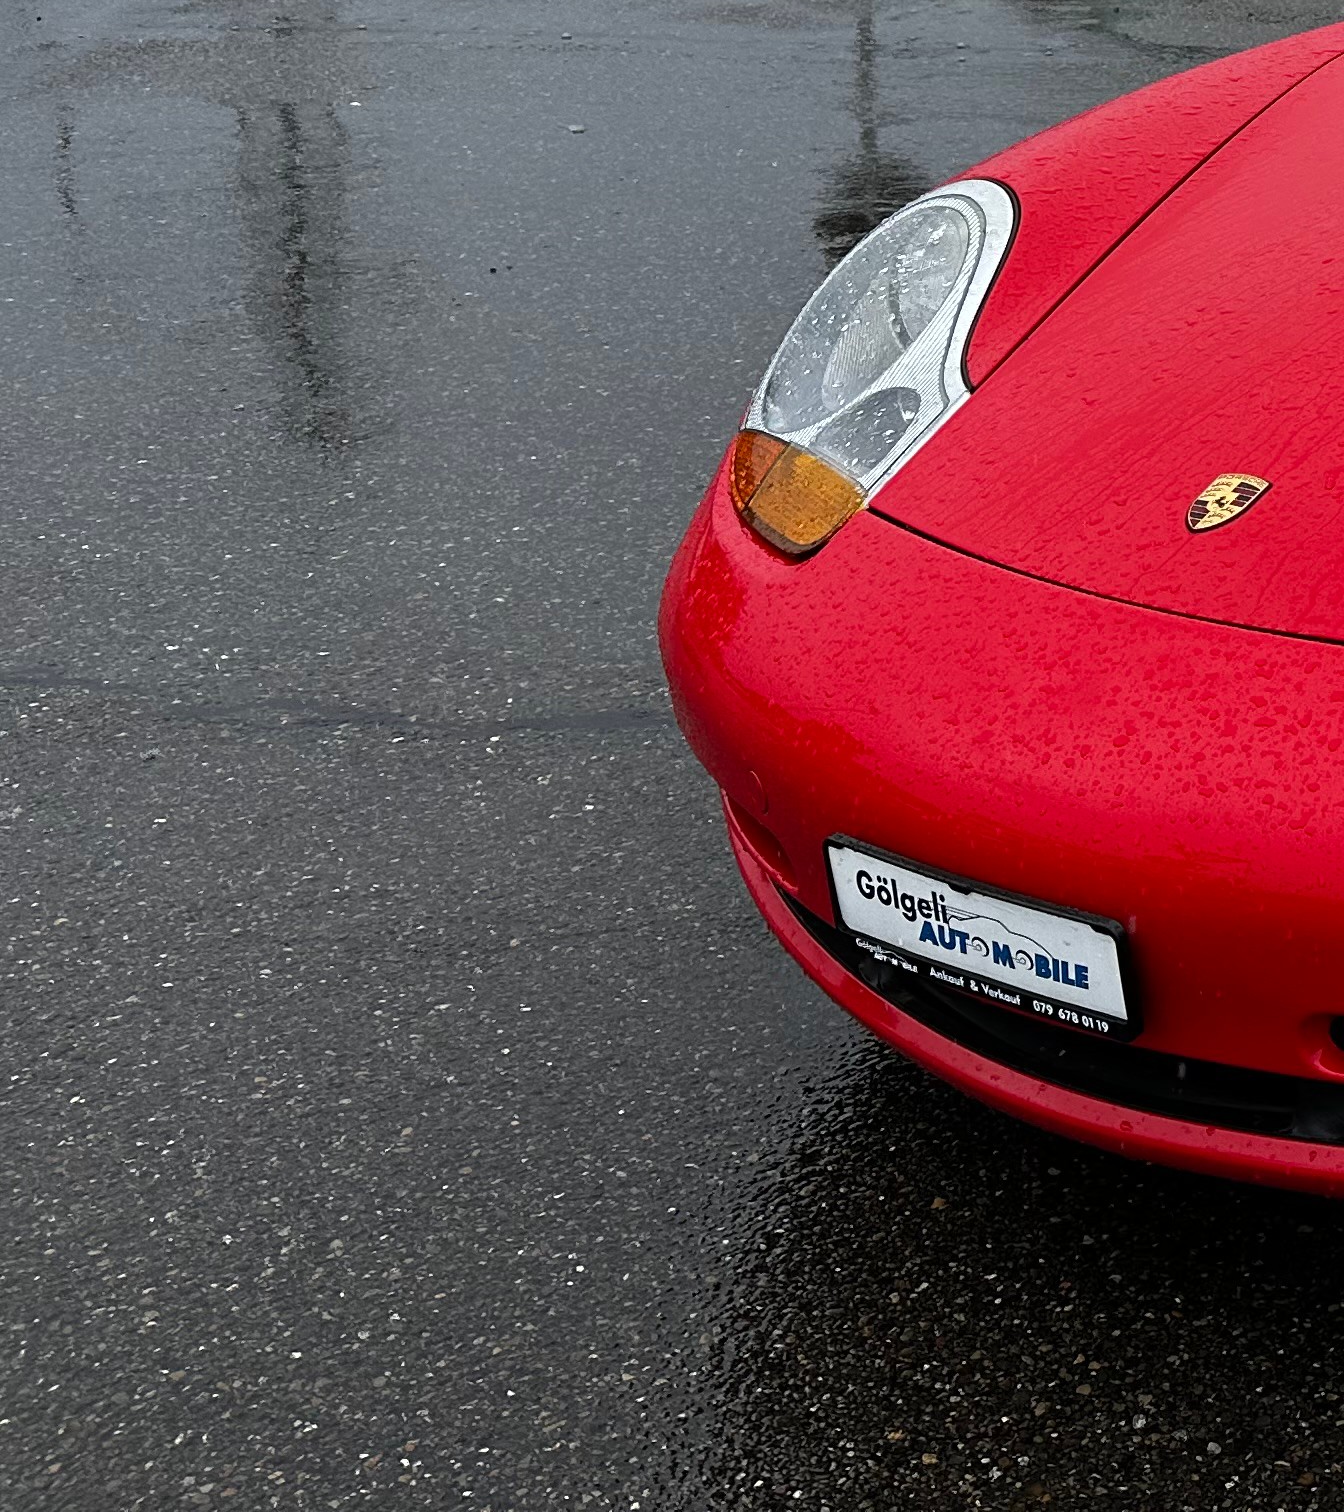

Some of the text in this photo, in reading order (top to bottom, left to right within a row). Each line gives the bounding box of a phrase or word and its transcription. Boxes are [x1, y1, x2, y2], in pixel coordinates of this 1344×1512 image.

[856, 869, 948, 925] Gölgeli
[919, 920, 1090, 990] AUTOMOBILE
[929, 966, 965, 988] Ankauf
[969, 979, 980, 993] &
[981, 982, 1021, 1006] Verkauf
[1032, 999, 1054, 1016] 079
[1058, 1008, 1080, 1024] 678
